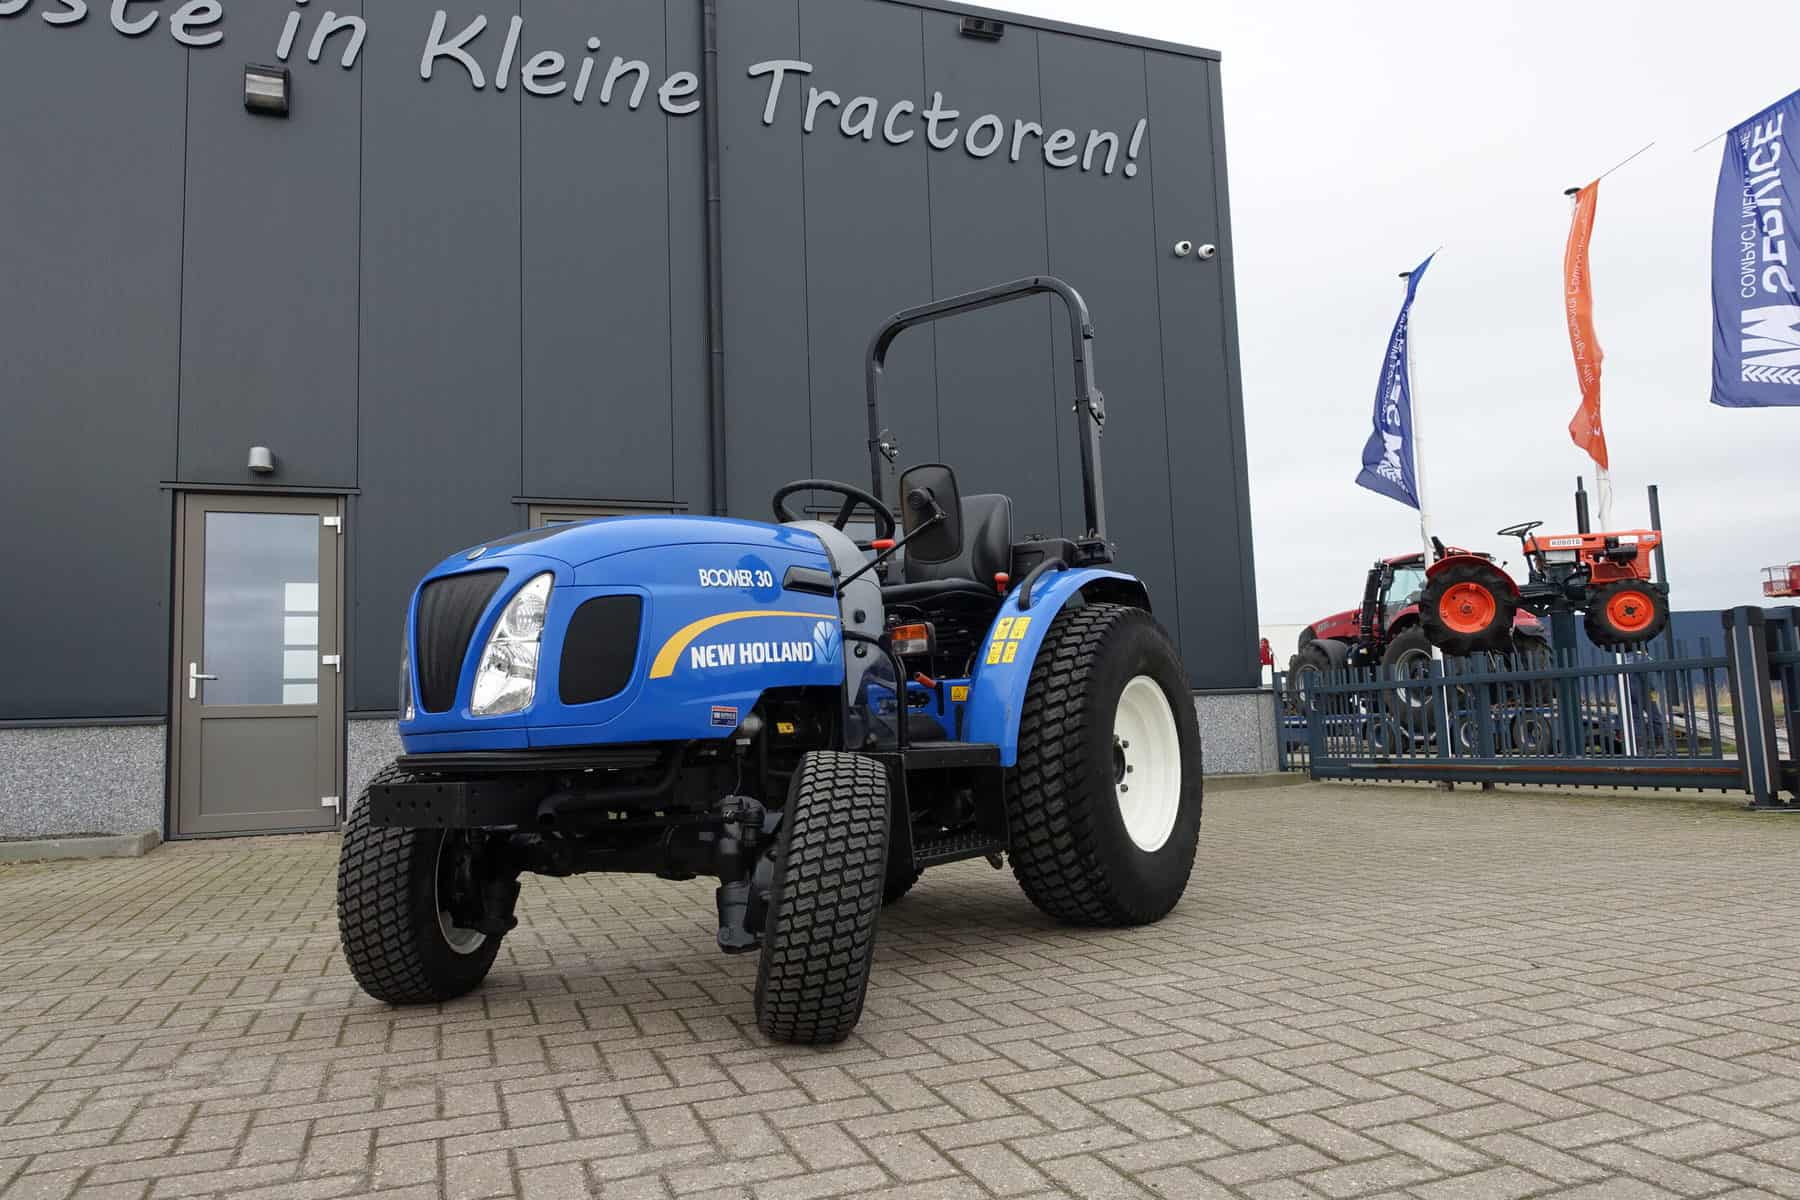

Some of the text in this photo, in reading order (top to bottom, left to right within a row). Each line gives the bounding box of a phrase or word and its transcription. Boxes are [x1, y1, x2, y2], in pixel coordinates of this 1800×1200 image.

[276, 0, 367, 69] in
[420, 9, 702, 116] Kleine
[747, 59, 1147, 178] Tractoren!
[698, 568, 773, 588] BOOMER 30
[690, 640, 814, 670] NEW HOLLAND
